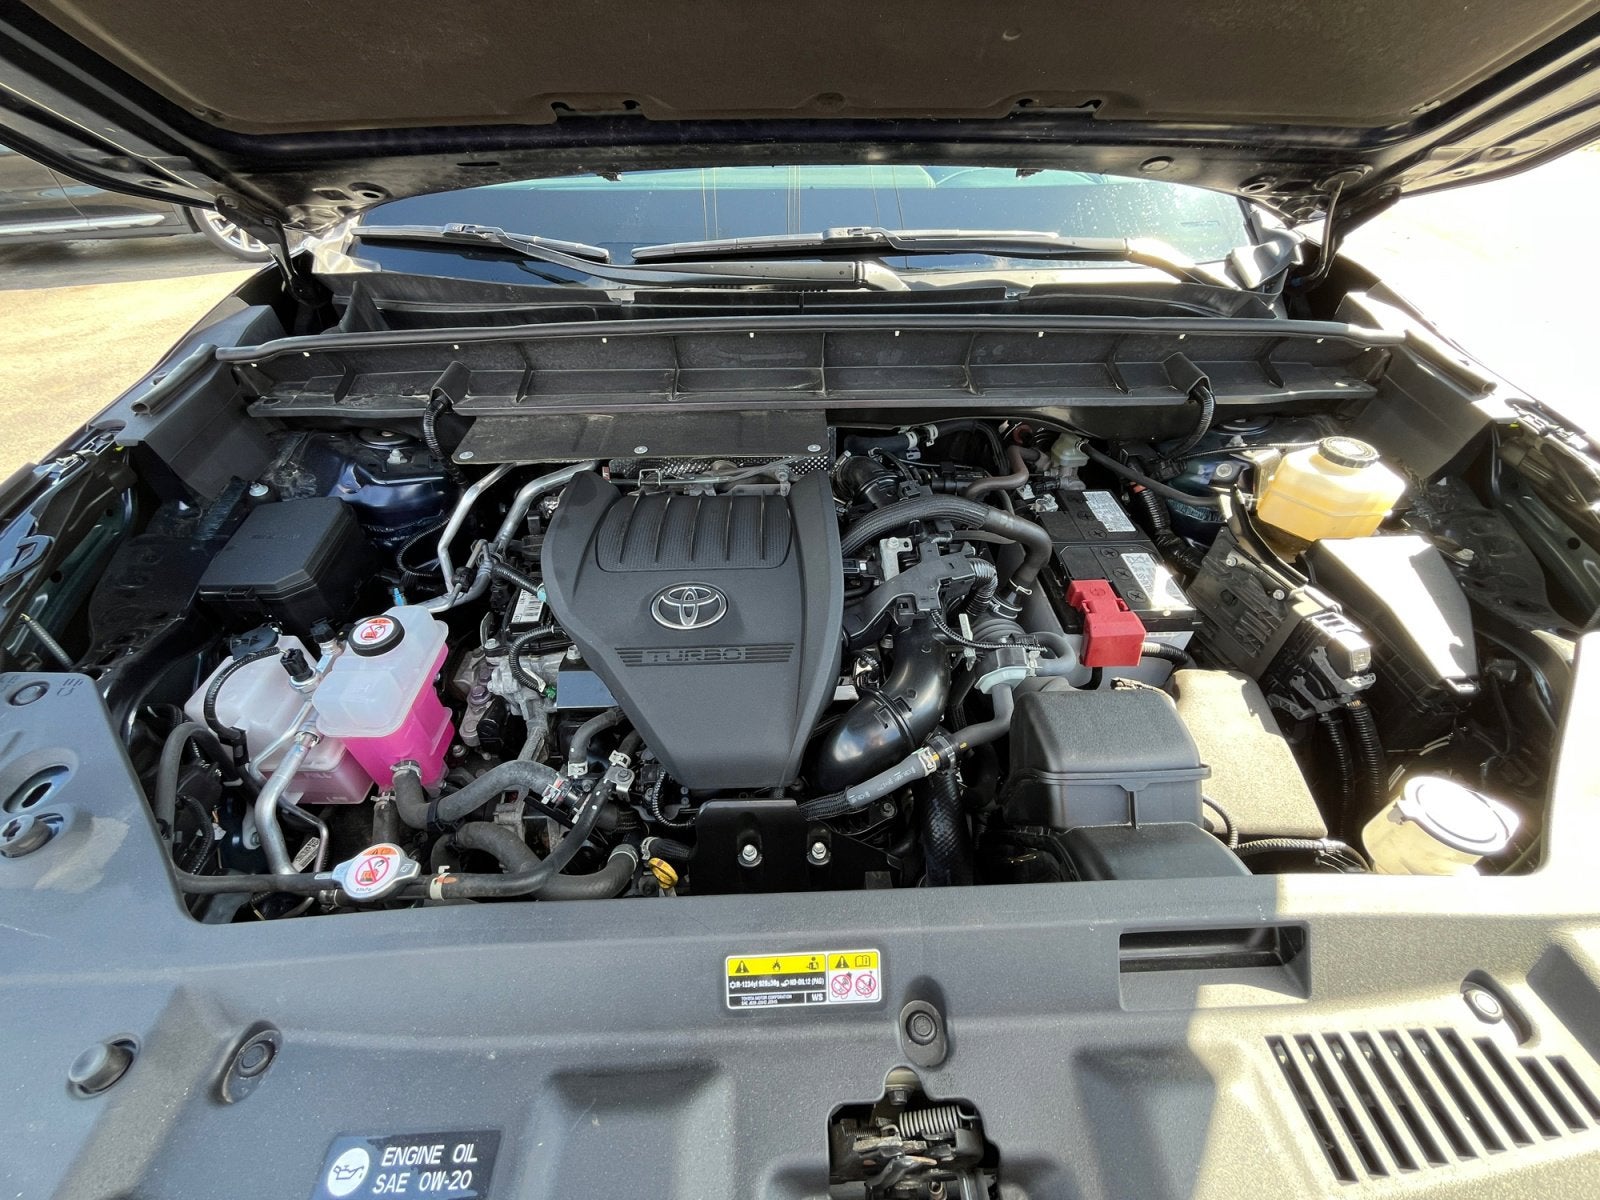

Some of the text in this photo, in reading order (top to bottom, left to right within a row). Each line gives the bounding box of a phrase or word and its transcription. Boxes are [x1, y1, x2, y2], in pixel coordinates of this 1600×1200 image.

[646, 648, 742, 662] TURBO
[811, 993, 824, 1001] WS
[381, 1143, 478, 1167] ENGINE OIL
[372, 1169, 473, 1194] SAE 0W-20
